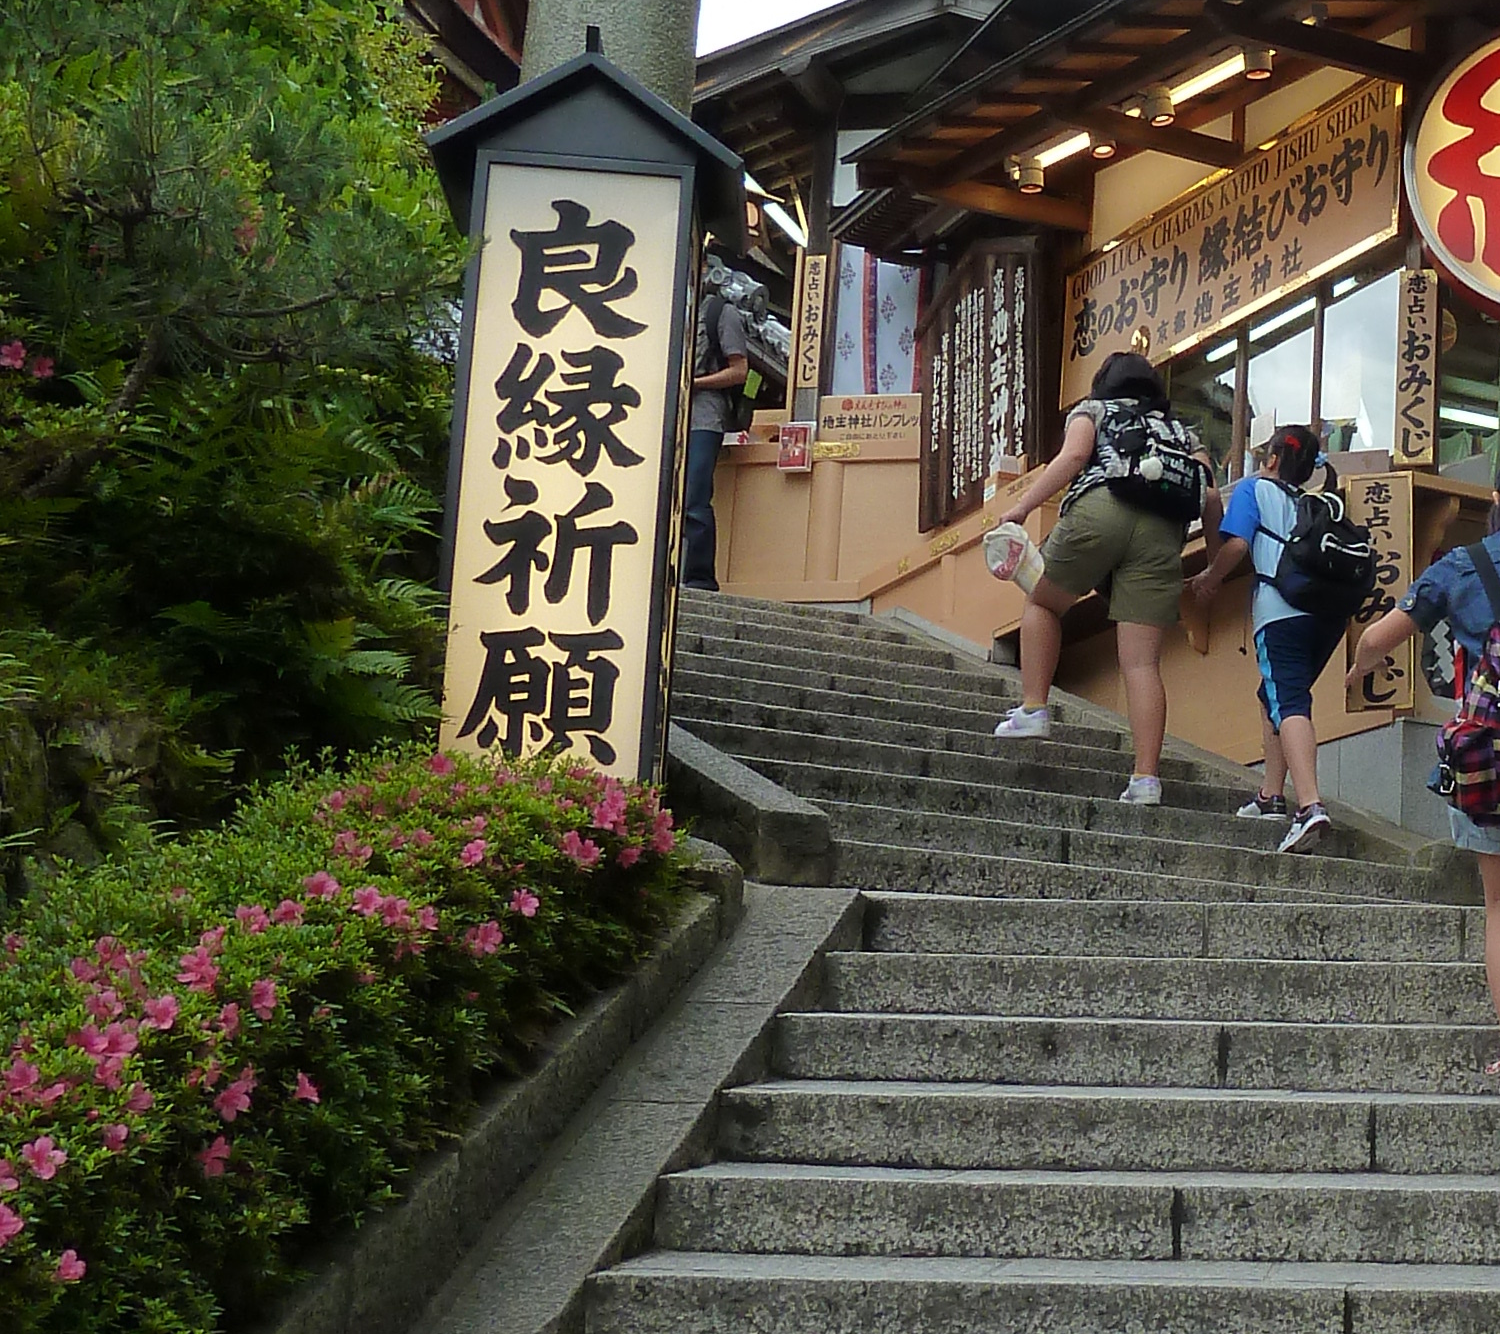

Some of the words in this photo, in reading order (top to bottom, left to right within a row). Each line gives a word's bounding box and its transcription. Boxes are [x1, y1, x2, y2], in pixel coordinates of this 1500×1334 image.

[1070, 244, 1190, 361] 恋のお守り
[1198, 123, 1390, 286] 縁結びお守り
[1072, 258, 1111, 300] GOOD
[1111, 234, 1147, 279] LUCK
[1152, 196, 1215, 249] CHARMS
[1219, 156, 1270, 208] KYOTO
[1274, 129, 1321, 181] JISHU
[1326, 86, 1392, 143] SHRINE
[802, 260, 821, 382] 恋占いおみくじ
[1398, 274, 1432, 458] 恋占いおみくじ
[456, 199, 648, 766] 良縁祈願
[1353, 481, 1405, 703] 恋占いおみじ
